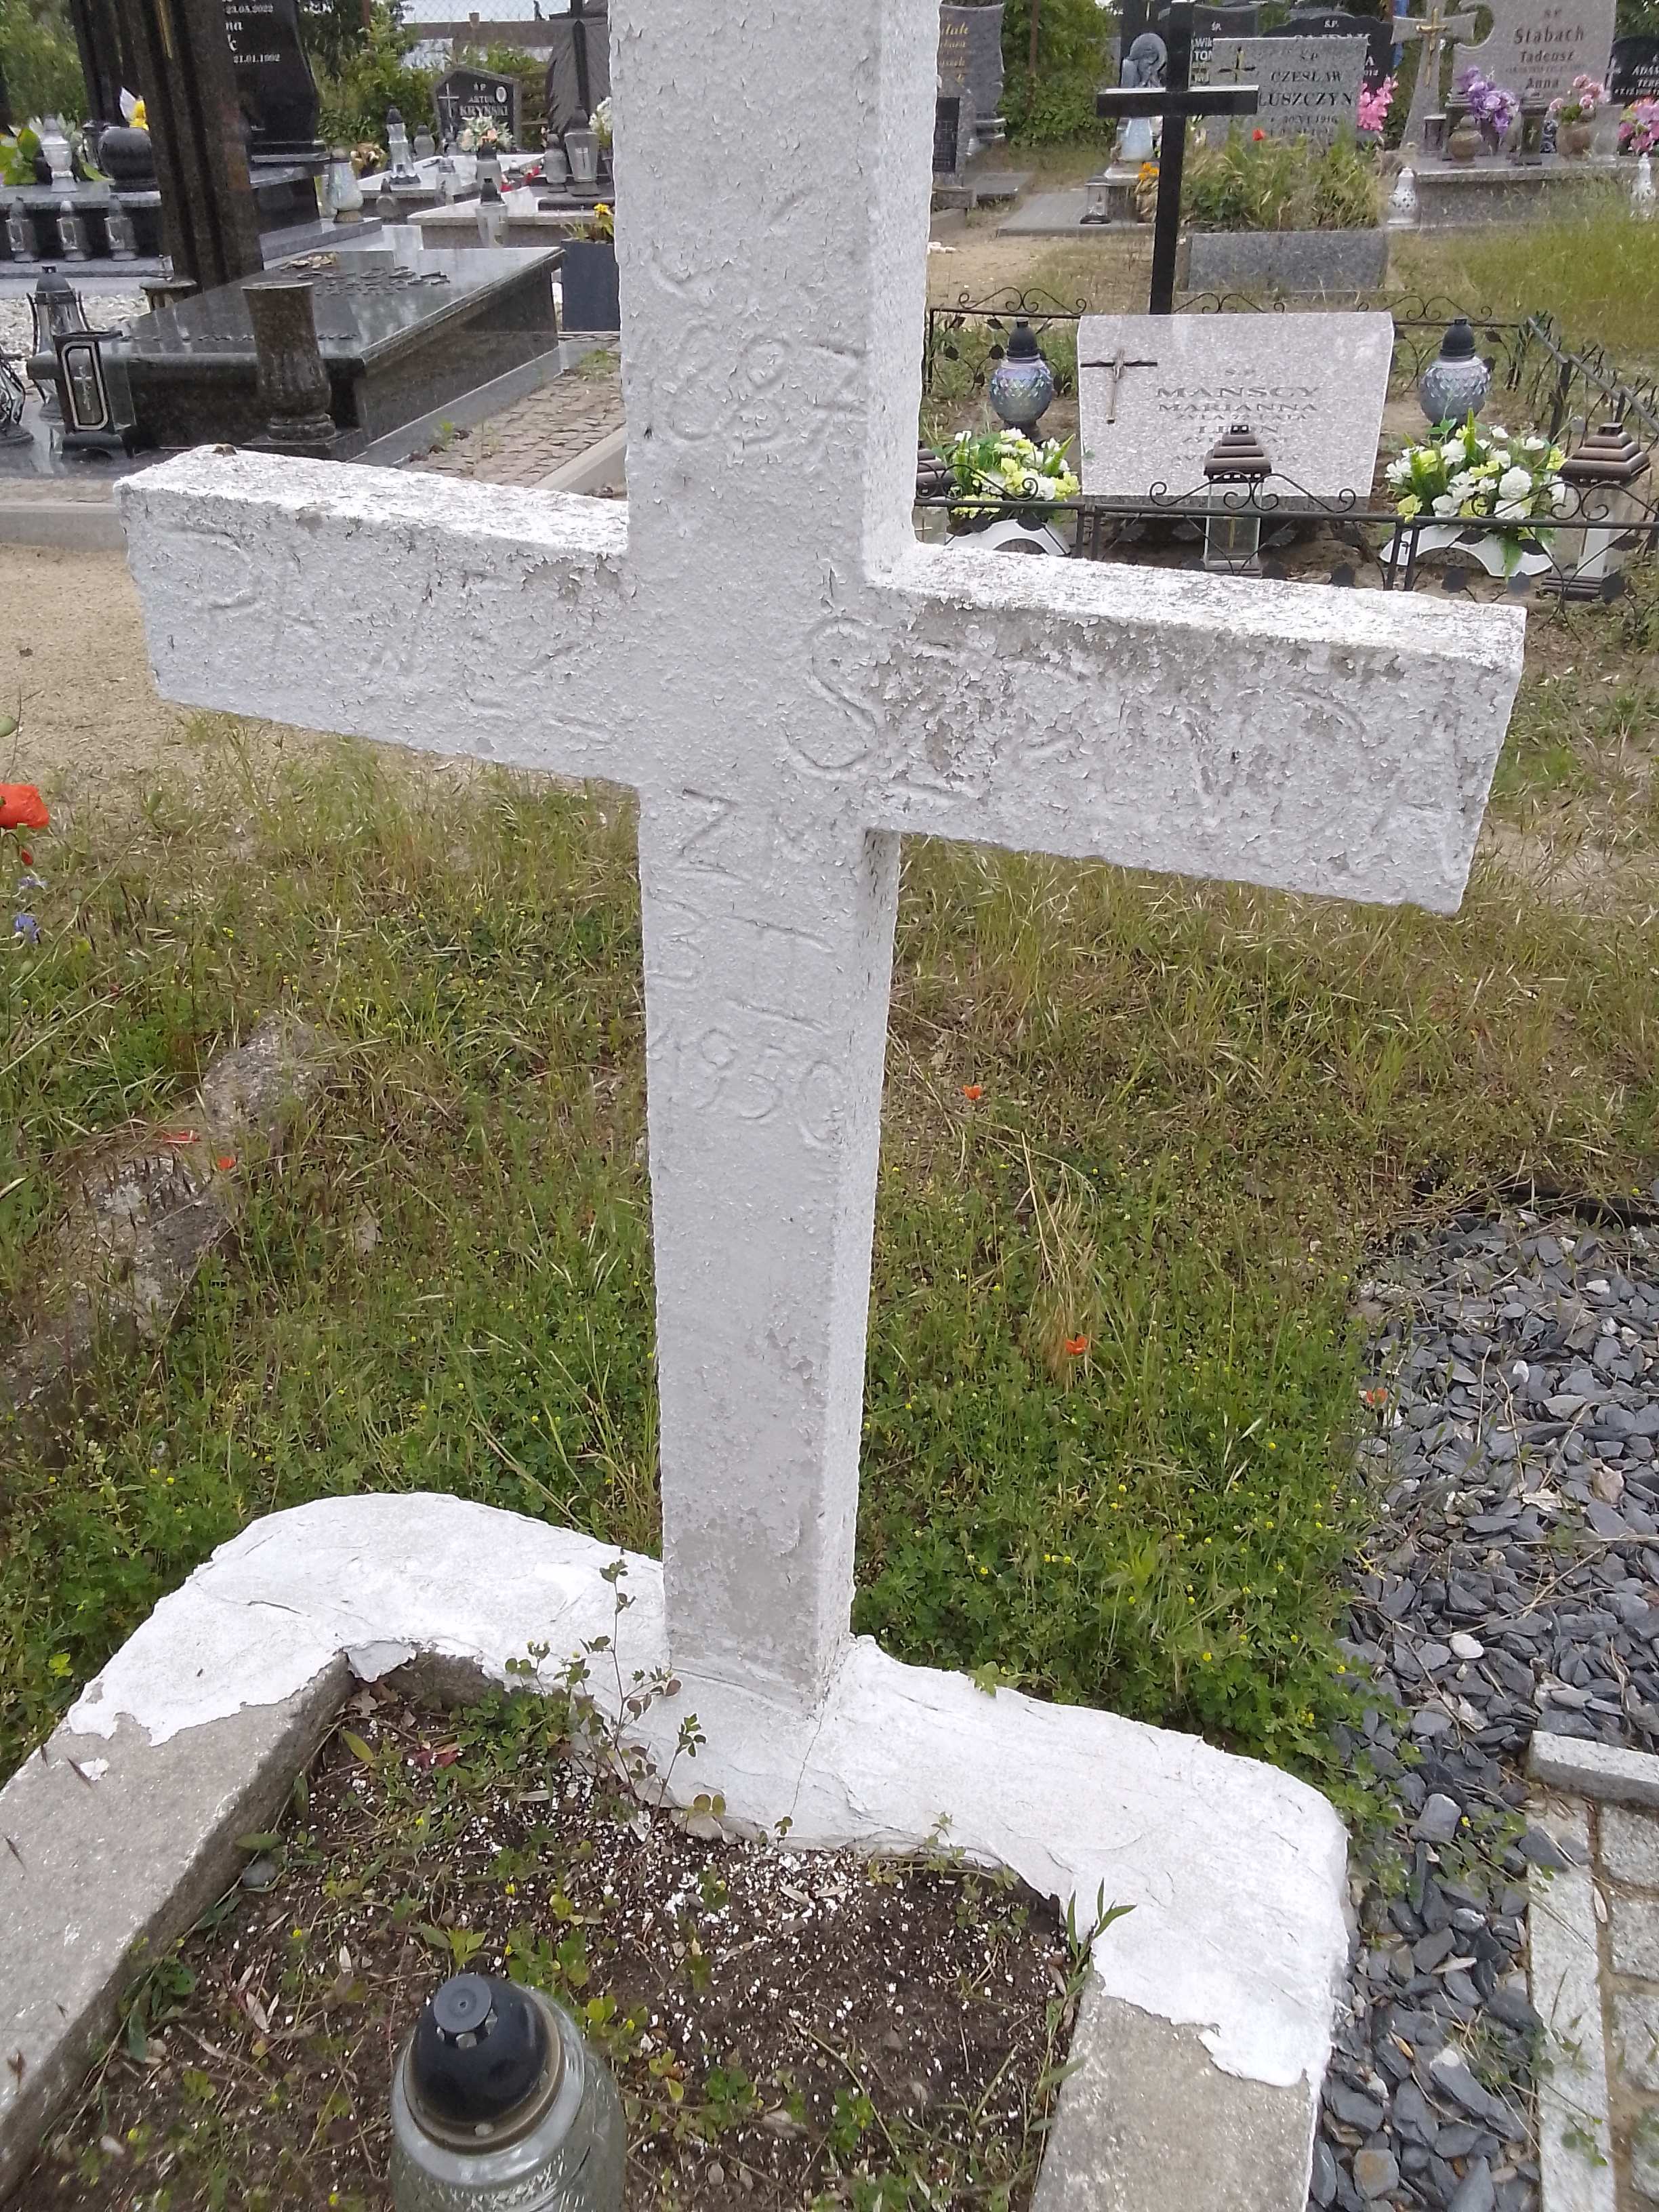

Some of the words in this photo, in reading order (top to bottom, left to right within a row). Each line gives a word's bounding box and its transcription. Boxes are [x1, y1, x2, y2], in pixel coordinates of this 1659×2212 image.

[1154, 387, 1319, 398] MANSCY
[1158, 404, 1318, 412] MARIANNA
[1198, 425, 1280, 434] LEN
